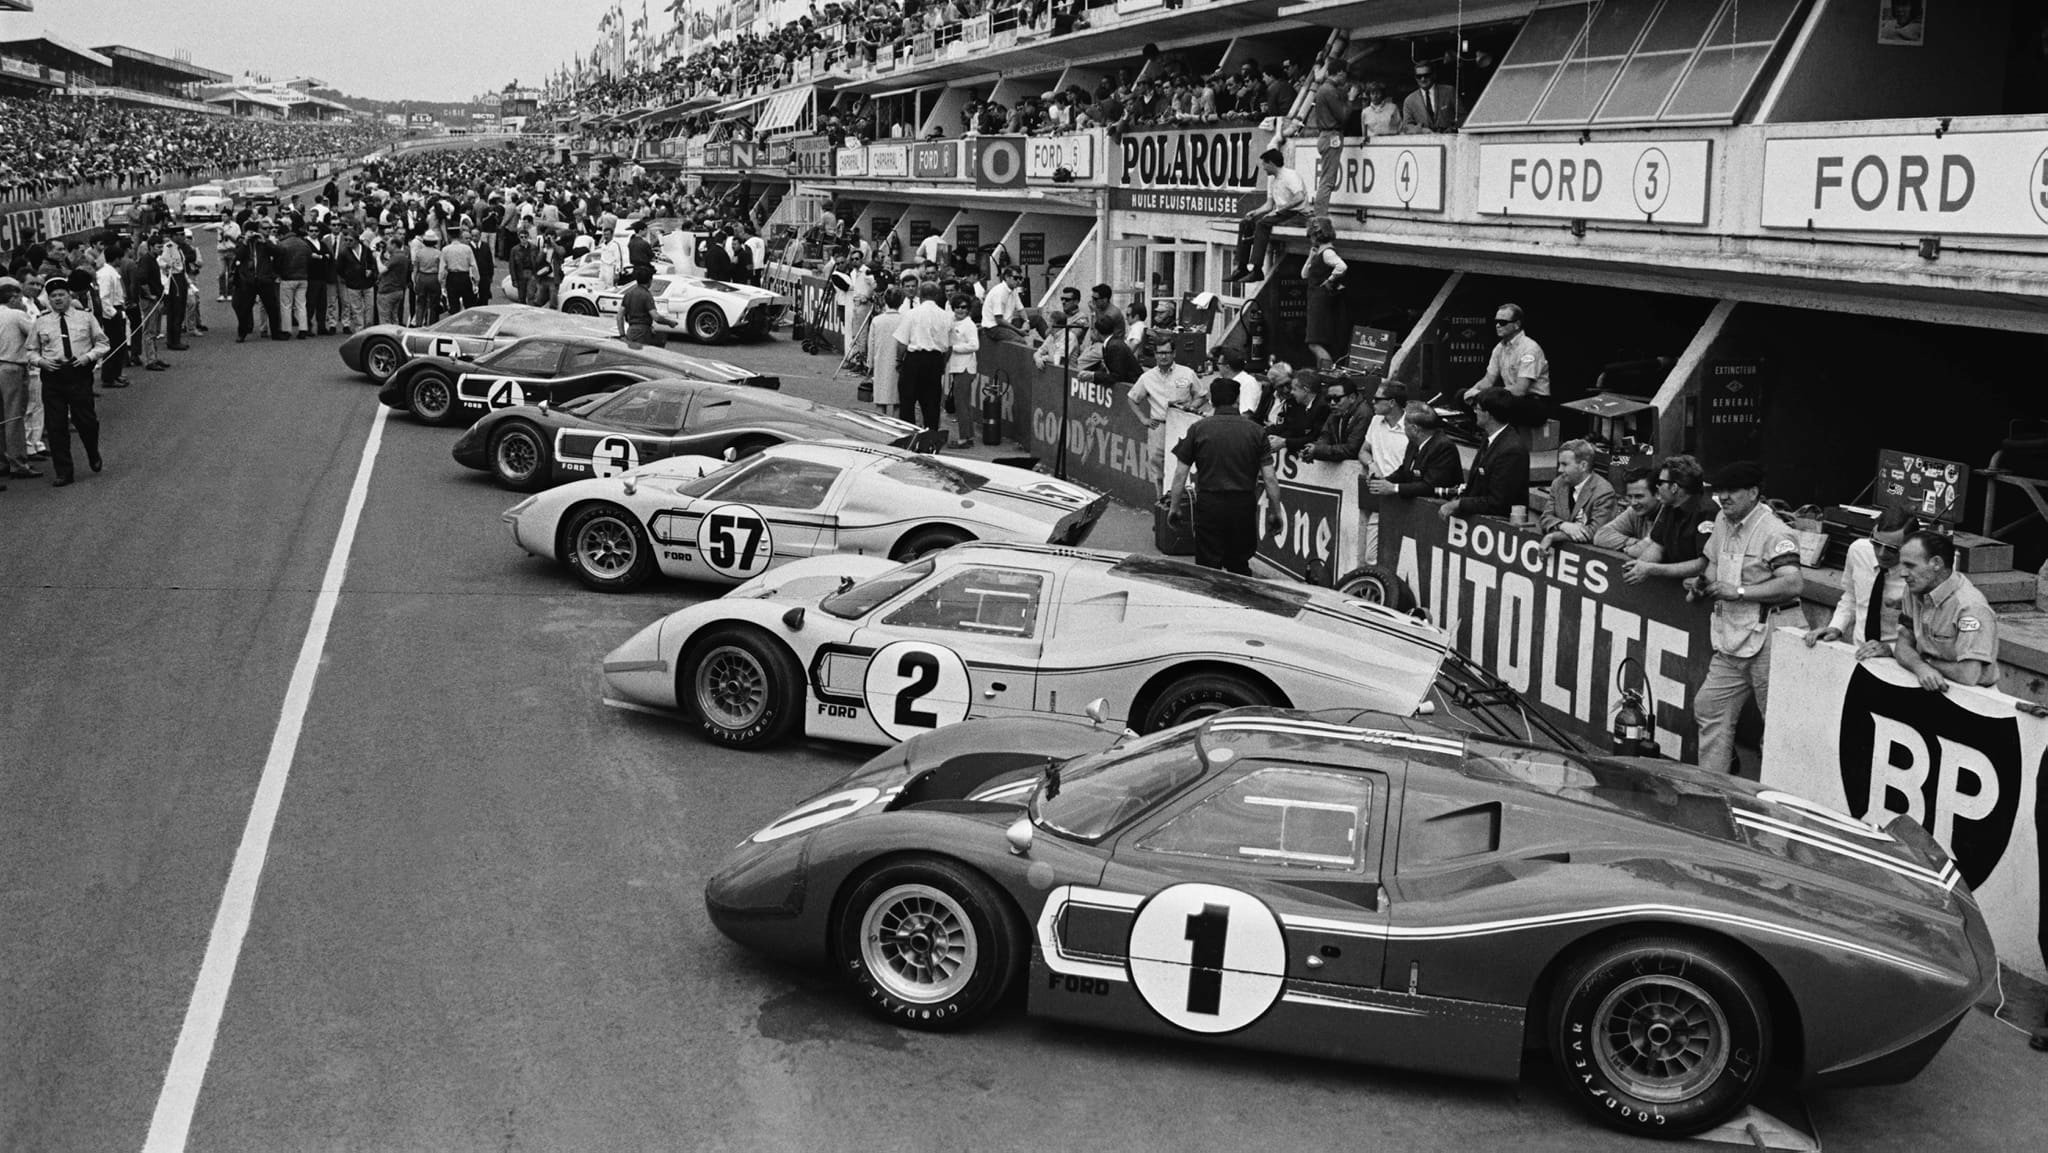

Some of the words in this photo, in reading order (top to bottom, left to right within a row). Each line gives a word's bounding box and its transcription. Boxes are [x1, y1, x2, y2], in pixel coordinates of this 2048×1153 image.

[732, 143, 753, 167] N
[797, 151, 830, 175] SOLE
[919, 150, 939, 170] FORD
[982, 141, 1020, 184] O
[1034, 145, 1062, 168] FORD
[1073, 146, 1078, 166] 5
[1119, 131, 1259, 188] POLAROIL
[1401, 161, 1410, 192] 4
[1510, 158, 1603, 202] FORD
[1645, 162, 1658, 200] 3
[1814, 154, 1975, 212] FORD
[1132, 194, 1157, 208] HUILE
[60, 203, 96, 234] BARDAHL
[1715, 366, 1756, 374] EXTINCTEUR
[490, 381, 517, 408] 4
[1070, 377, 1112, 408] PNEUS
[1712, 415, 1752, 423] INCENDIE
[562, 463, 585, 471] FORD
[605, 438, 630, 478] 3
[664, 551, 692, 561] FORD
[709, 514, 764, 570] 57
[1447, 516, 1609, 594] BOUGIES
[1396, 535, 1690, 761] AUTOLITE
[894, 651, 940, 729] 2
[818, 704, 857, 718] FORD
[1860, 711, 2000, 860] BP
[1184, 903, 1230, 1016] 1
[1049, 974, 1109, 997] FORD
